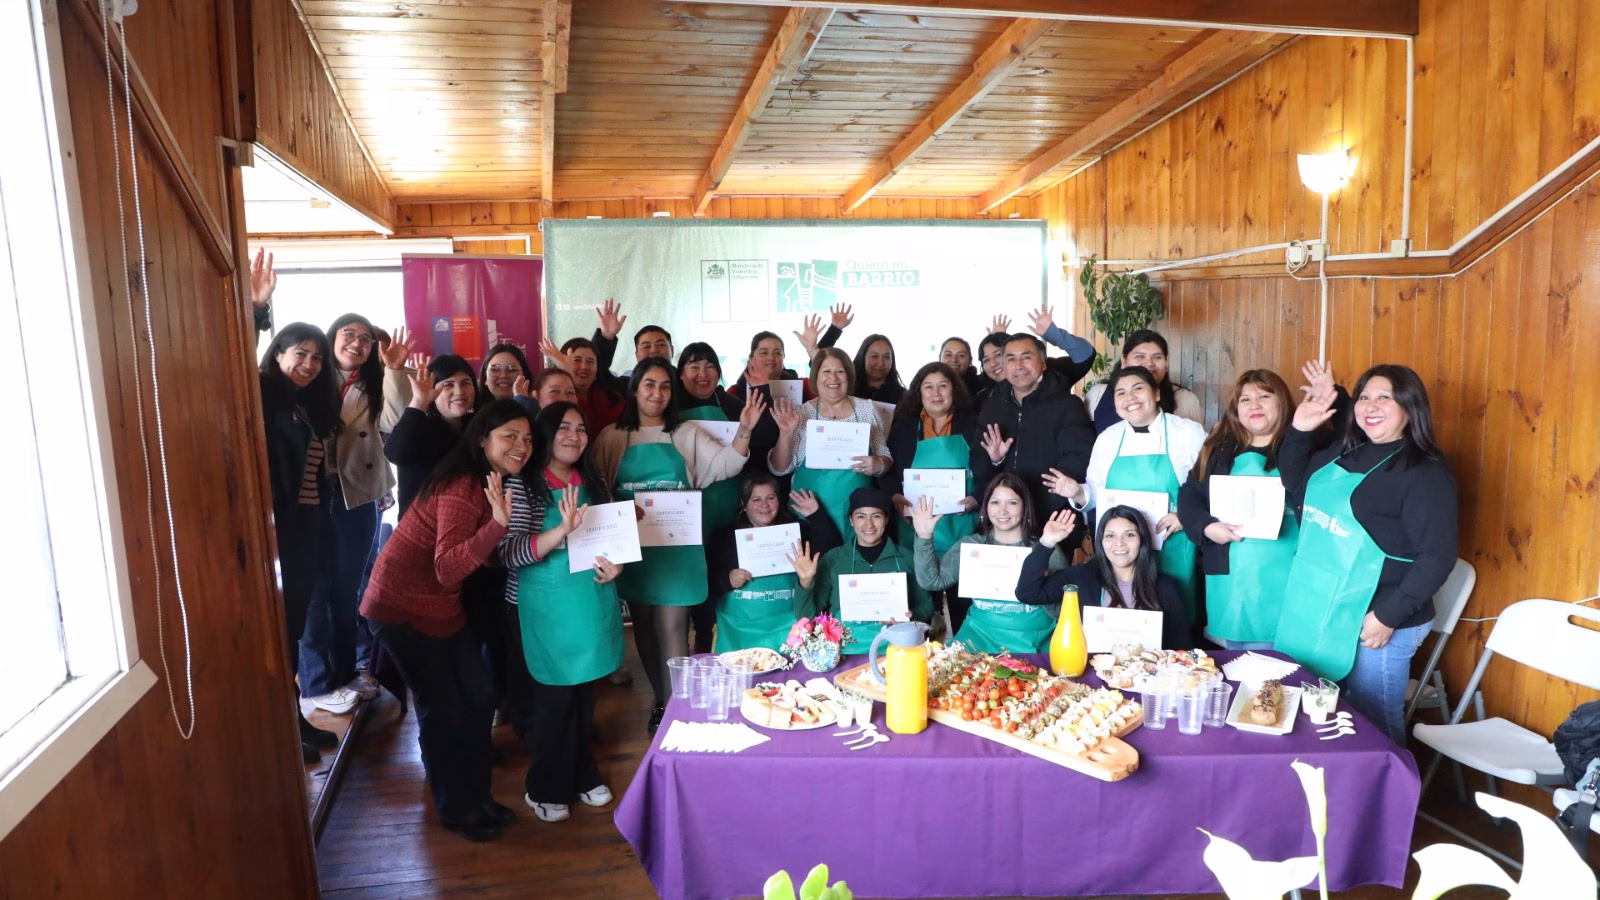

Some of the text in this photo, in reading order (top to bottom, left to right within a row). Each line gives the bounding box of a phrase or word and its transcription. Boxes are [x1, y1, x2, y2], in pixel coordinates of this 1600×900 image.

[846, 258, 908, 270] Quiero mi
[847, 271, 916, 287] BARRIO
